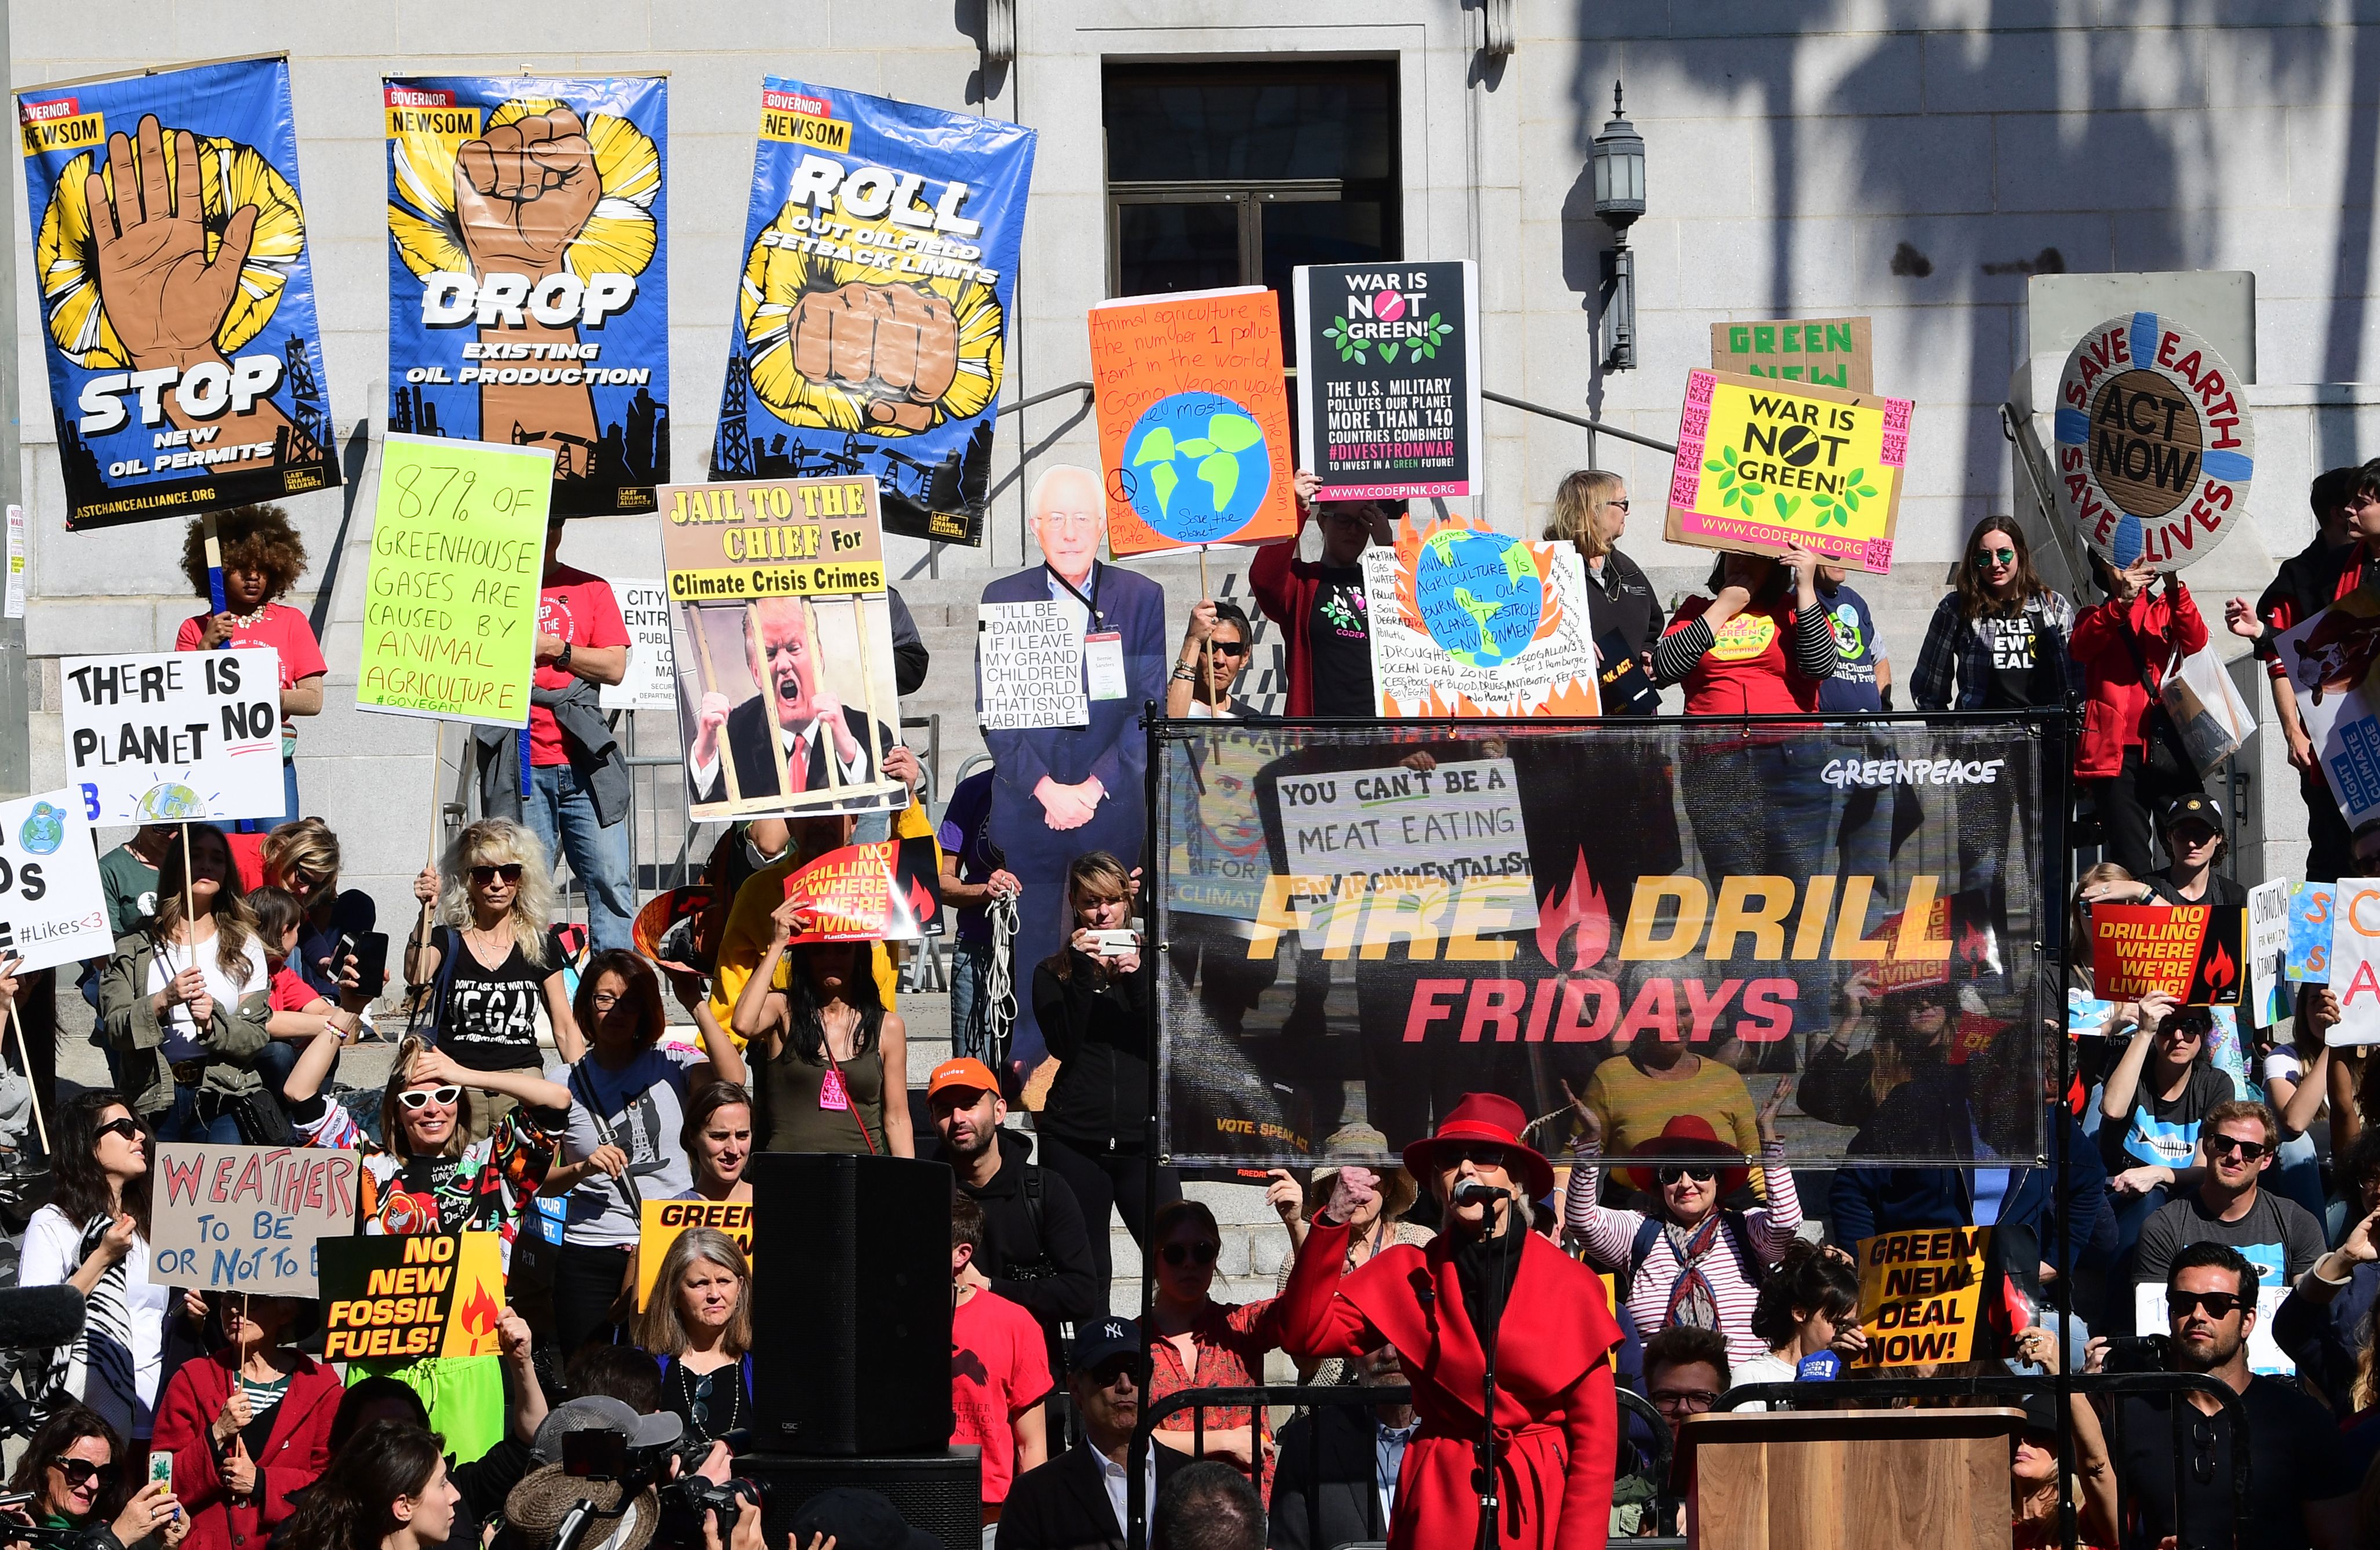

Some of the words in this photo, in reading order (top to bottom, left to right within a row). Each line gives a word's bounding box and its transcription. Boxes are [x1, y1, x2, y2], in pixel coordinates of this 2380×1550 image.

[390, 91, 446, 106] GOVERNOR
[767, 94, 821, 115] GOVERNOR
[25, 118, 97, 150] NEWSOM
[392, 112, 473, 133] NEWSOM
[765, 113, 845, 147] NEWSOM
[788, 153, 980, 236] ROLL
[791, 216, 850, 238] OUT
[854, 230, 981, 260] OILFIELD
[761, 231, 897, 268] SETBACK
[898, 259, 999, 285] LIMITS
[1345, 273, 1401, 290] WAR
[1408, 272, 1428, 289] IS
[421, 271, 637, 325] DROP
[1092, 308, 1147, 335] Animal
[1154, 300, 1248, 339] agriculture
[1259, 300, 1272, 316] is
[1348, 321, 1428, 339] GREEN!
[462, 343, 599, 359] EXISTING
[1728, 322, 1853, 354] GREEN
[406, 367, 452, 383] OIL
[458, 368, 649, 384] PRODUCTION
[1327, 381, 1352, 397] THE
[1358, 380, 1384, 396] U.S.
[1389, 379, 1451, 395] MILITARY
[2066, 328, 2129, 410] SAVE
[2157, 331, 2242, 449] EARTH
[78, 354, 283, 434] STOP
[1328, 398, 1381, 412] POLLUTES
[1385, 397, 1407, 409] OUR
[1413, 396, 1452, 409] PLANET
[1886, 399, 1909, 407] MAKE
[1329, 412, 1370, 430] MORE
[1377, 410, 1417, 428] THAN
[1426, 409, 1453, 427] 140
[1749, 394, 1819, 426] WAR
[1830, 408, 1855, 431] IS
[1884, 420, 1906, 429] WAR
[2097, 384, 2185, 442] ACT
[153, 426, 219, 449] NEW
[1329, 430, 1389, 444] COUNTRIES
[1394, 428, 1454, 442] COMBINED!
[1329, 441, 1454, 460] #DIVESTFROMWAR
[108, 460, 148, 477] OIL
[154, 441, 274, 471] PERMITS
[2095, 430, 2197, 493] NOW
[395, 464, 477, 521] 87%
[493, 487, 534, 516] OF
[1329, 485, 1455, 497] WWW.CODEPINK.ORG
[1738, 460, 1846, 496] GREEN!
[669, 489, 744, 523] JAIL
[748, 486, 792, 519] TO
[798, 483, 867, 518] THE
[2062, 447, 2116, 545] SAVE
[2145, 479, 2233, 562] LIVES
[376, 526, 535, 573] GREENHOUSE
[722, 524, 821, 561] CHIEF
[831, 530, 862, 552] For
[1701, 518, 1863, 555] WWW.CODEPINK.ORG
[1420, 551, 1468, 576] ANIMAL
[374, 567, 454, 601] GASES
[472, 579, 520, 608] ARE
[673, 574, 745, 595] Climate
[754, 569, 806, 592] Crisis
[814, 567, 879, 590] Crimes
[1418, 563, 1507, 598] AGRICULTURE
[1495, 581, 1529, 599] OUR
[627, 590, 665, 606] CITY
[1035, 603, 1057, 616] BE
[1422, 591, 1483, 620] BURNING
[369, 603, 452, 631] CAUSED
[478, 615, 515, 638] BY
[993, 618, 1068, 635] DAMNED
[1447, 617, 1539, 654] ENVIRONMENT
[377, 631, 493, 667] ANIMAL
[991, 637, 1004, 651] IF
[1011, 637, 1014, 650] I
[1018, 633, 1073, 649] LEAVE
[1716, 647, 1760, 655] CODEPINK
[986, 653, 1011, 666] MY
[1015, 650, 1078, 665] GRAND
[987, 665, 1077, 682] CHILDREN
[1616, 658, 1633, 676] ACT.
[67, 660, 184, 705] THERE
[205, 657, 241, 695] IS
[366, 666, 515, 709] AGRICULTURE
[995, 683, 1006, 696] A
[1011, 681, 1075, 696] WORLD
[376, 694, 462, 714] #GOVEGAN
[221, 702, 274, 741] NO
[73, 723, 209, 767] PLANET
[1281, 780, 1337, 806] YOU
[1355, 770, 1432, 801] CAN'T
[1443, 770, 1480, 794] BE
[1487, 767, 1507, 789] A
[1821, 759, 2004, 789] GREENPEACE
[2338, 764, 2364, 809] FIGHT
[77, 783, 101, 821] B
[1298, 820, 1380, 855] MEAT
[1402, 806, 1514, 845] EATING
[859, 843, 893, 860] NO
[792, 860, 891, 893] DRILLING
[807, 878, 888, 896] WHERE
[1291, 851, 1531, 905] ENVIRONMENTALIST
[816, 897, 886, 913] WE'RE
[1247, 875, 1534, 960] FIRE
[1618, 875, 1953, 960] DRILL
[2170, 907, 2204, 923] NO
[20, 912, 103, 943] #Likes<3
[2099, 922, 2200, 940] DRILLING
[2116, 941, 2196, 958] WHERE
[2123, 960, 2192, 977] WE'RE
[455, 980, 476, 989] DON'T
[478, 983, 493, 991] ASK
[495, 983, 506, 991] ME
[507, 980, 524, 990] WHY
[2109, 977, 2186, 995] LIVING!
[1403, 978, 1799, 1042] FRIDAYS
[162, 1148, 354, 1218] WEATHER
[254, 1211, 294, 1240] BE
[156, 1247, 198, 1275] OR
[403, 1236, 456, 1264] NO
[1869, 1230, 1979, 1267] GREEN
[367, 1266, 452, 1296] NEW
[1884, 1264, 1972, 1297] NEW
[328, 1297, 445, 1329] FOSSIL
[1877, 1298, 1965, 1330] DEAL
[325, 1325, 439, 1359] FUELS!
[1862, 1331, 1957, 1364] NOW!
